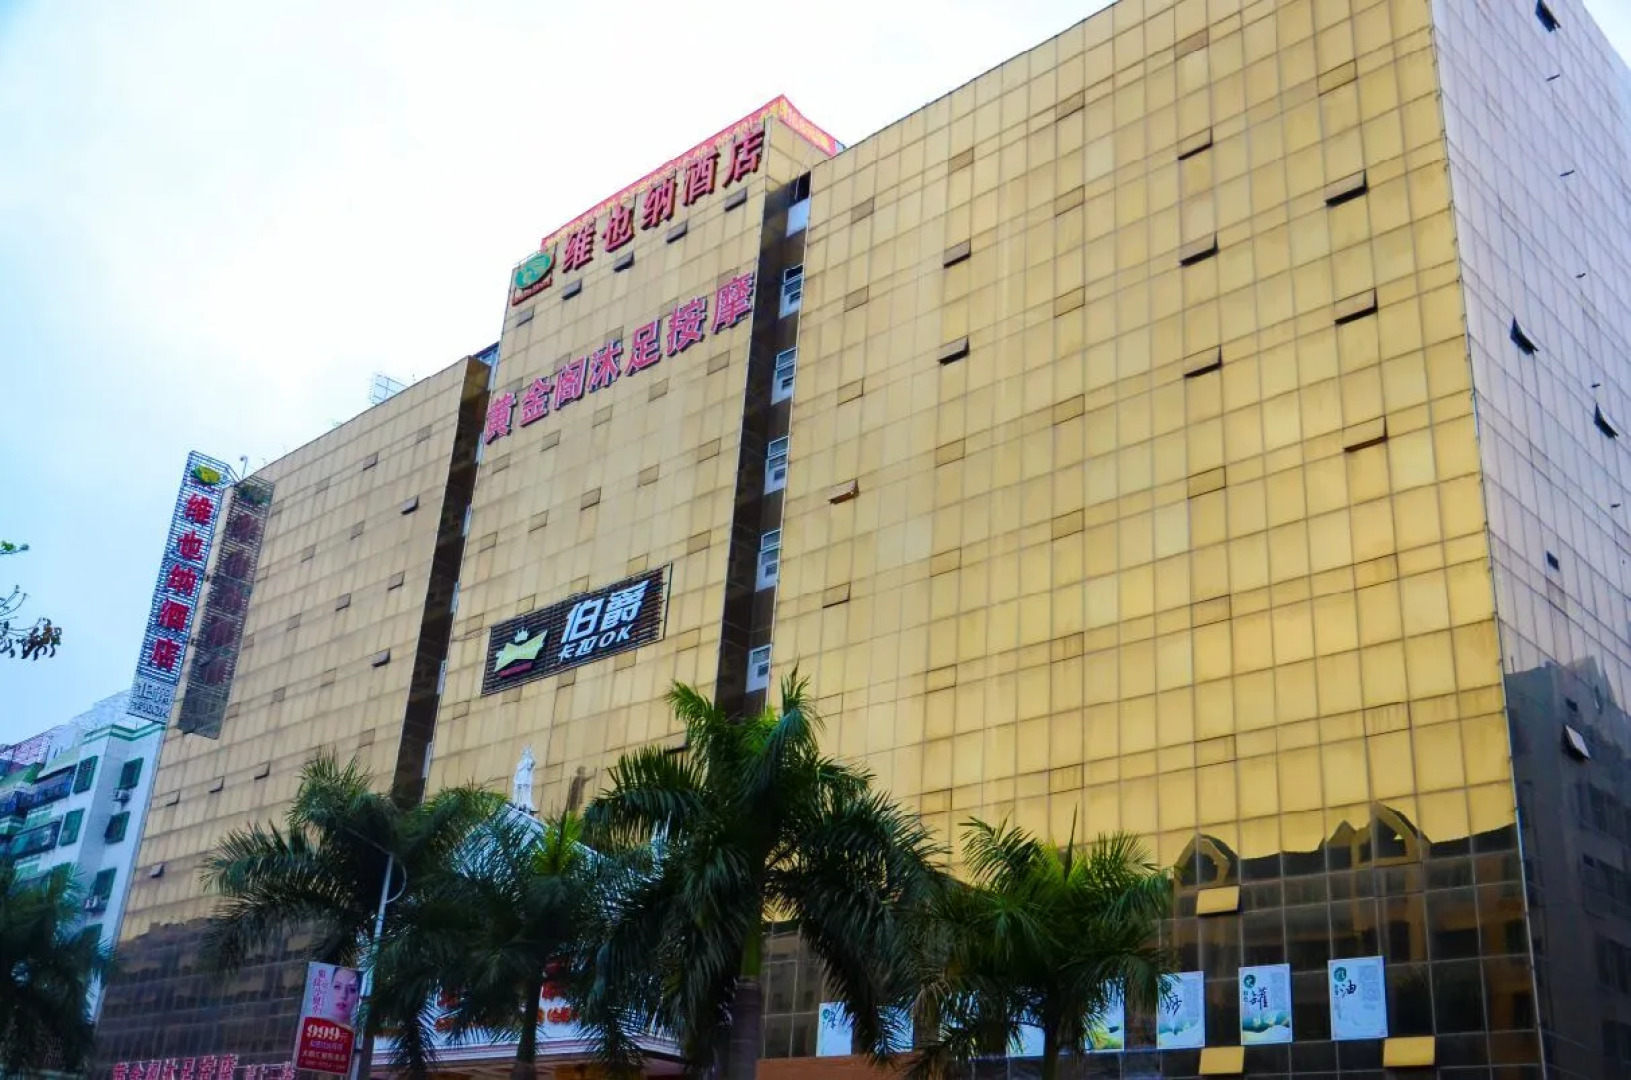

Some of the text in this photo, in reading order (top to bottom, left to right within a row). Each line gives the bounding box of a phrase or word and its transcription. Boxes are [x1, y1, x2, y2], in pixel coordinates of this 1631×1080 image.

[562, 128, 765, 274] 维也纳酒店
[483, 270, 755, 445] 黄金阁沐足按摩
[151, 492, 214, 672] 维也纳酒店
[558, 624, 633, 662] 卡拉OK
[561, 580, 650, 643] 伯爵
